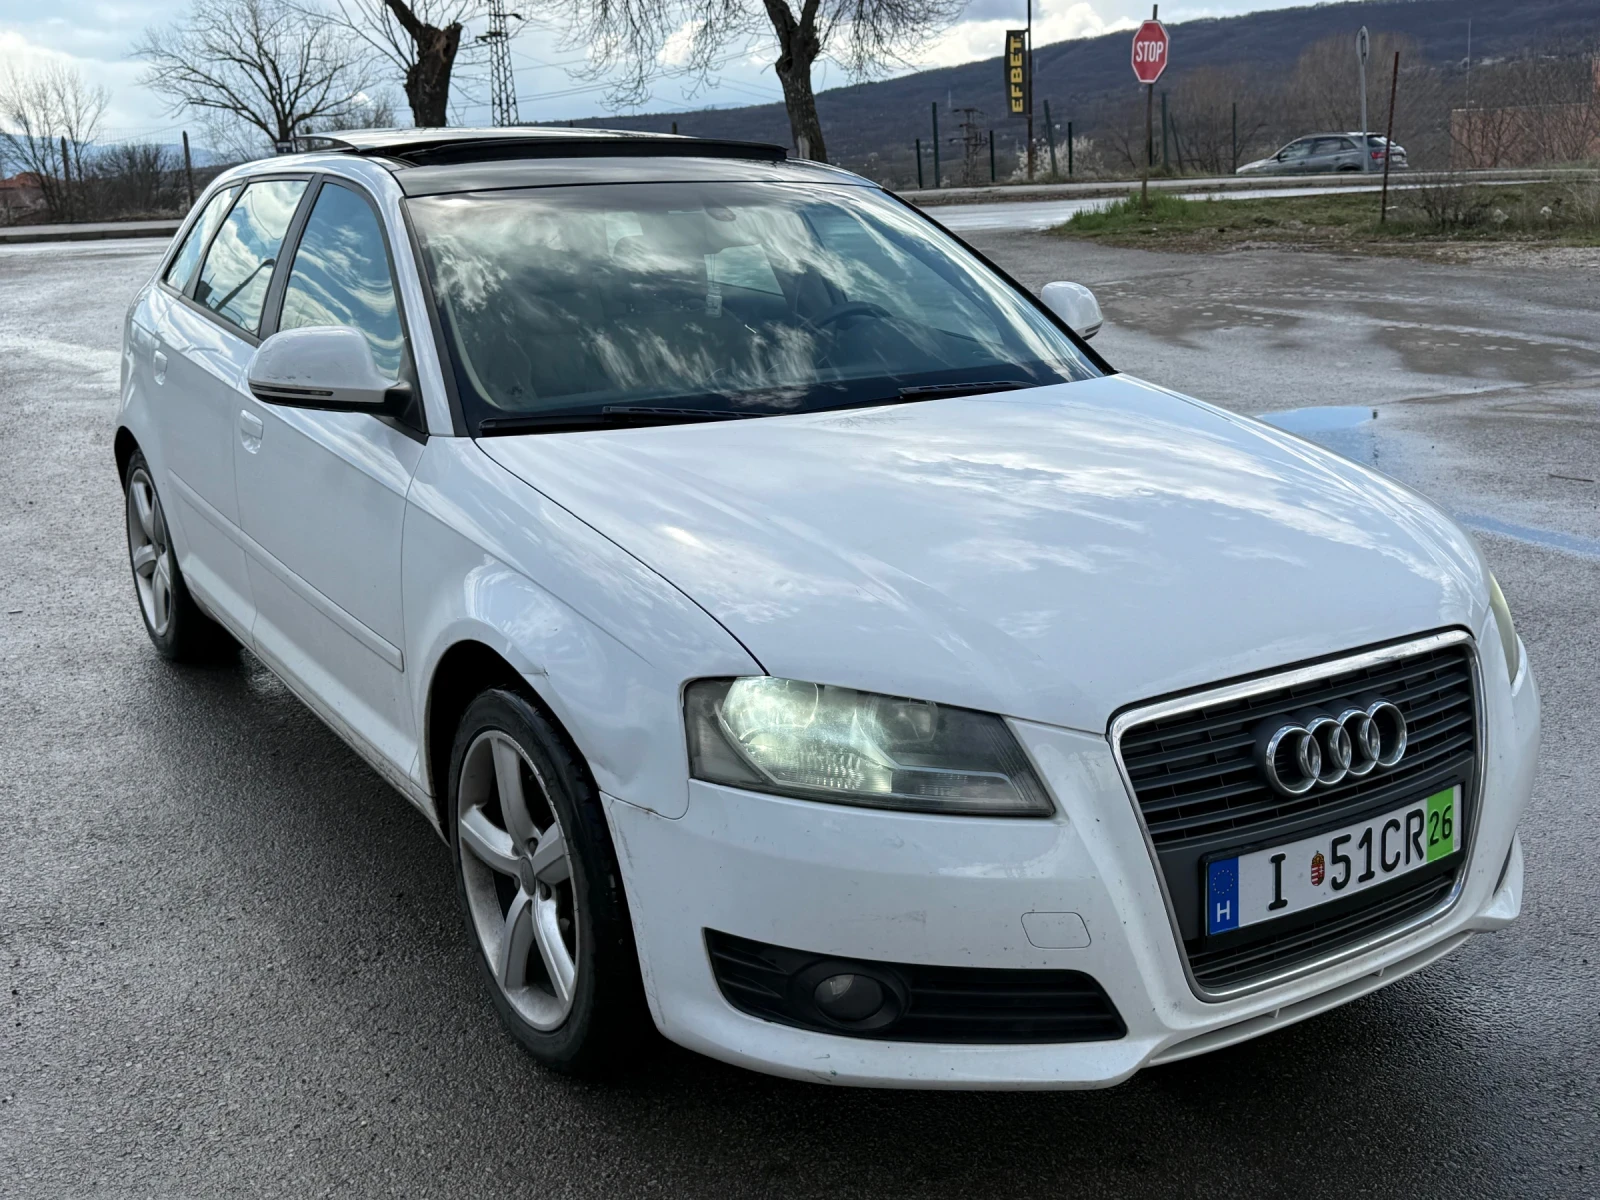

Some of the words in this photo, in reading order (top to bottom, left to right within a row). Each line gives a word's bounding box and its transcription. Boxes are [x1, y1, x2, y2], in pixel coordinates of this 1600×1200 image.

[1010, 36, 1024, 113] EFBET
[1135, 41, 1164, 62] STOP
[1268, 853, 1288, 911] I
[1429, 804, 1452, 847] 26
[1216, 900, 1231, 923] H
